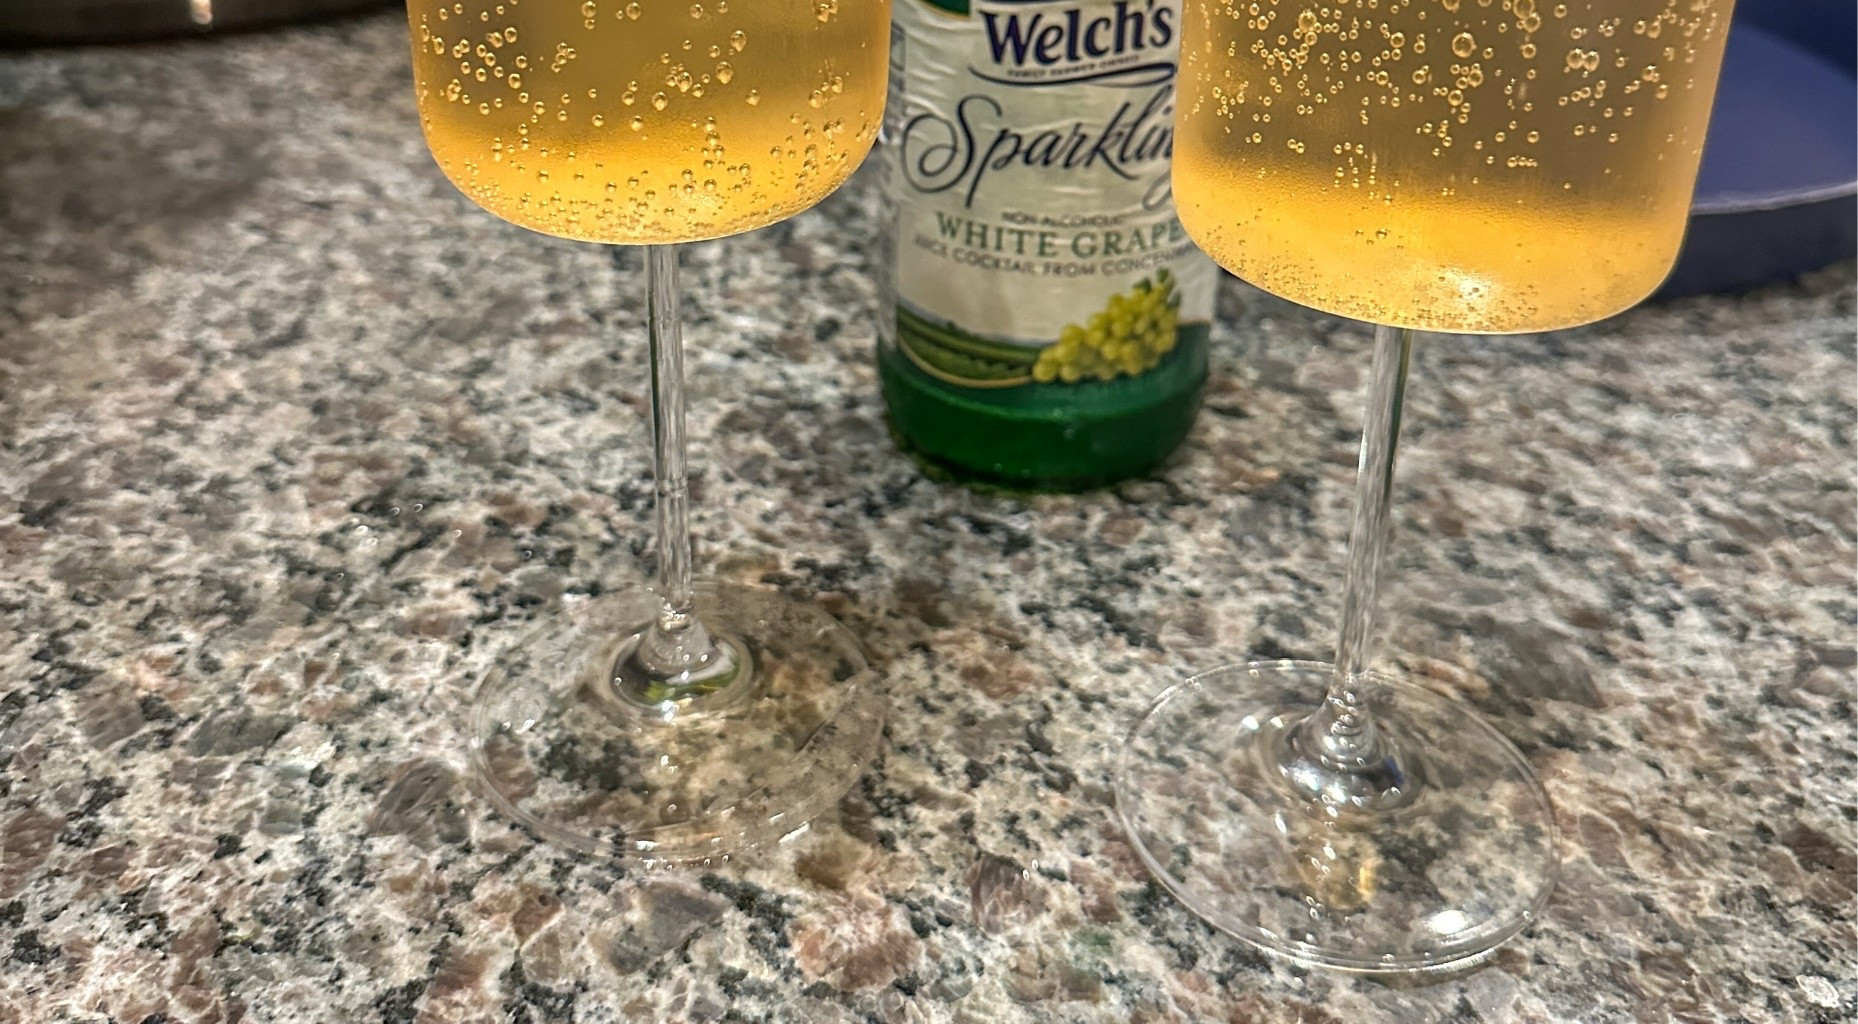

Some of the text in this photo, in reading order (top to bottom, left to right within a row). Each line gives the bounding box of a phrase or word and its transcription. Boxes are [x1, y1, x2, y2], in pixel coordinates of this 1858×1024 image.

[935, 210, 1185, 259] WHITE GRAPE
[1042, 262, 1096, 277] FROM
